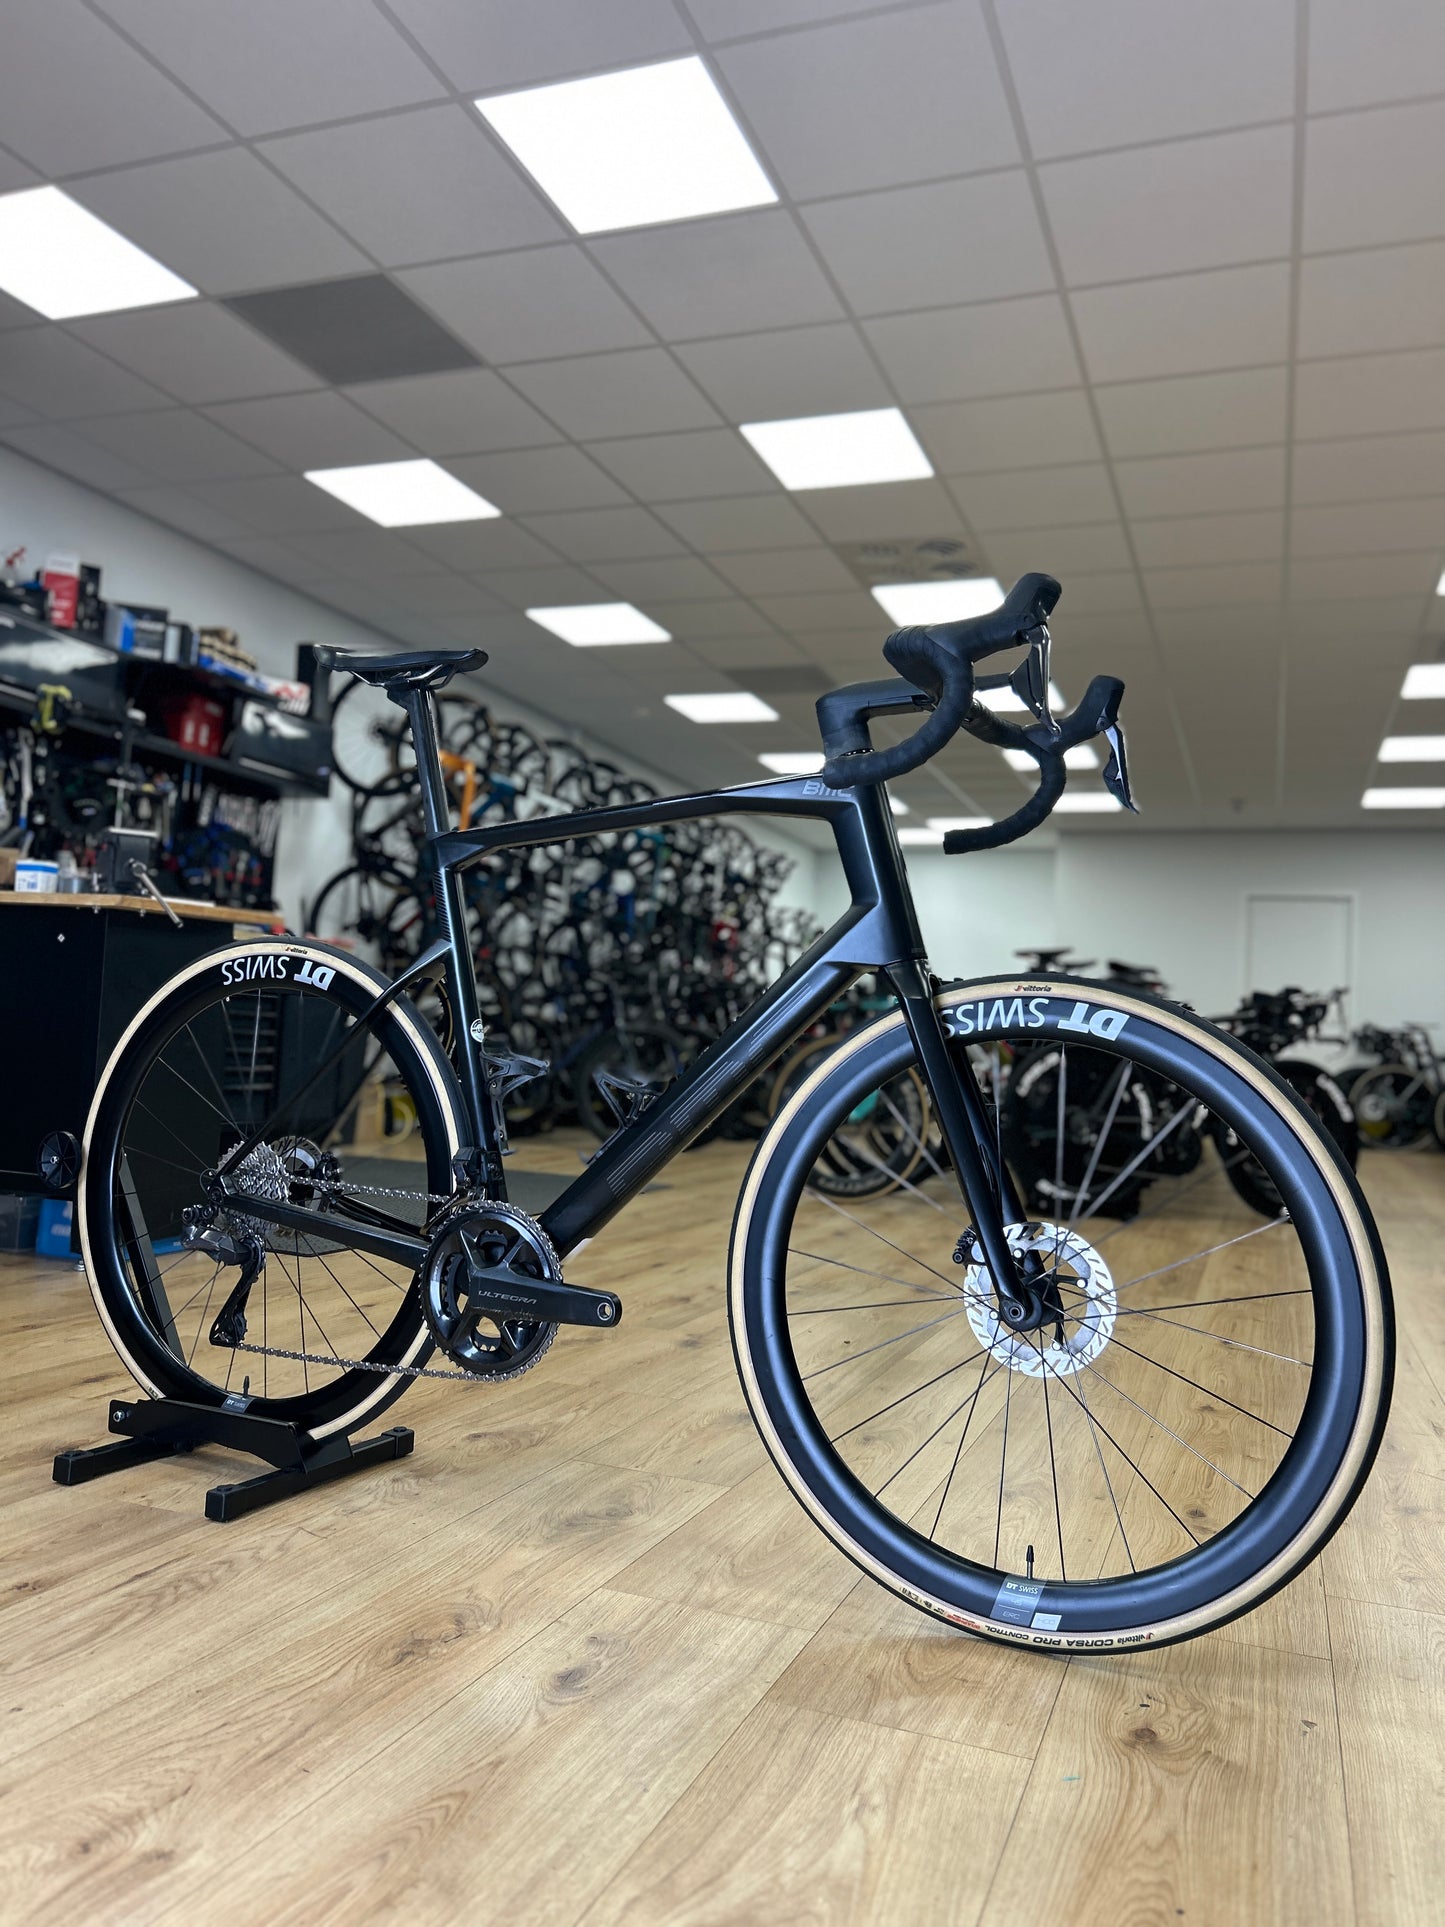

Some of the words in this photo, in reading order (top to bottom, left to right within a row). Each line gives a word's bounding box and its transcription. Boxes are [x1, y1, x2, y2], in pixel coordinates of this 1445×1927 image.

[221, 955, 290, 985] SWISS
[294, 960, 336, 991] DT
[1022, 984, 1052, 992] vittoria
[941, 998, 1049, 1038] SWISS
[1057, 1002, 1130, 1041] DT
[478, 1290, 537, 1305] ULTEGRA
[1006, 1581, 1018, 1590] DT
[1018, 1585, 1039, 1595] SWISS
[985, 1625, 1029, 1640] CONTROL
[1117, 1633, 1145, 1644] vittoria
[1033, 1636, 1061, 1646] PRO
[1066, 1639, 1113, 1647] CORSA
